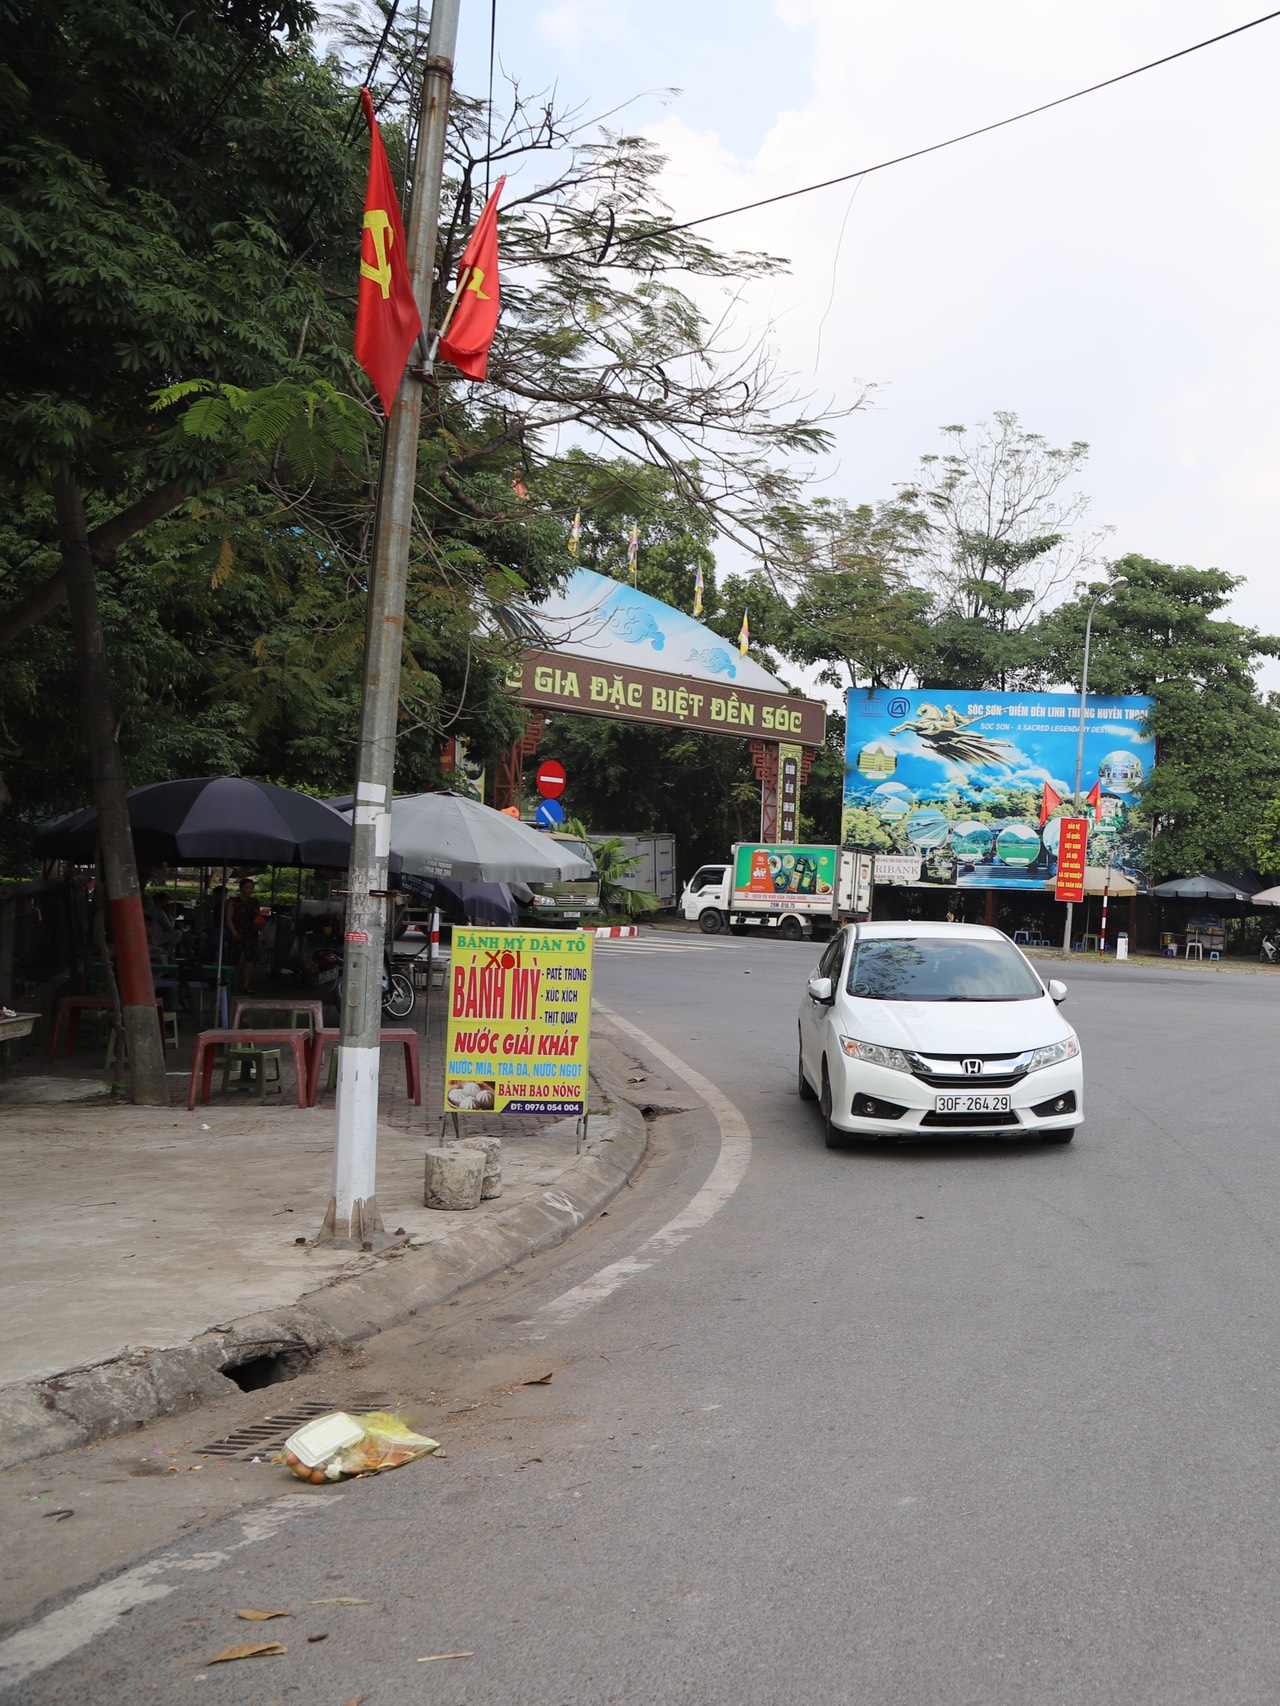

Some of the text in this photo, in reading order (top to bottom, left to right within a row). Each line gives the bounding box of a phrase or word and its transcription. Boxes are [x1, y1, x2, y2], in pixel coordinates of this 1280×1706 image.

[534, 666, 580, 698] GIA
[590, 674, 643, 710] ĐẶC
[652, 686, 704, 720] BIỆT
[710, 692, 754, 726] ĐỀN
[761, 704, 803, 733] SÓC
[967, 703, 984, 715] SÓC
[985, 704, 1001, 716] SƠN
[1009, 703, 1029, 717] ĐIỂM
[1030, 704, 1046, 717] ĐẾN
[1047, 707, 1065, 718] LINH
[1067, 707, 1094, 719] THING
[1097, 705, 1122, 720] HUYỀN
[1023, 724, 1049, 732] SACRED
[876, 865, 919, 874] RIBANK
[457, 933, 586, 952] BÁNH MỲ DÂN TỔ
[564, 966, 587, 981] TRỨNG
[453, 955, 541, 1020] BÁNH MỲ
[545, 987, 578, 1002] XÚC XÍCH
[544, 1011, 578, 1026] THỊT QUAY
[454, 1027, 579, 1056] NƯỚC GIẢI KHÁT
[448, 1058, 473, 1075] NƯỚC
[534, 1061, 557, 1077] NƯỚC
[560, 1064, 582, 1080] NGỌT
[498, 1081, 581, 1098] BÁNH BAO NÓNG
[510, 1103, 523, 1111] ĐT:
[525, 1103, 545, 1111] 0976
[938, 1097, 1008, 1111] 30F-264.29
